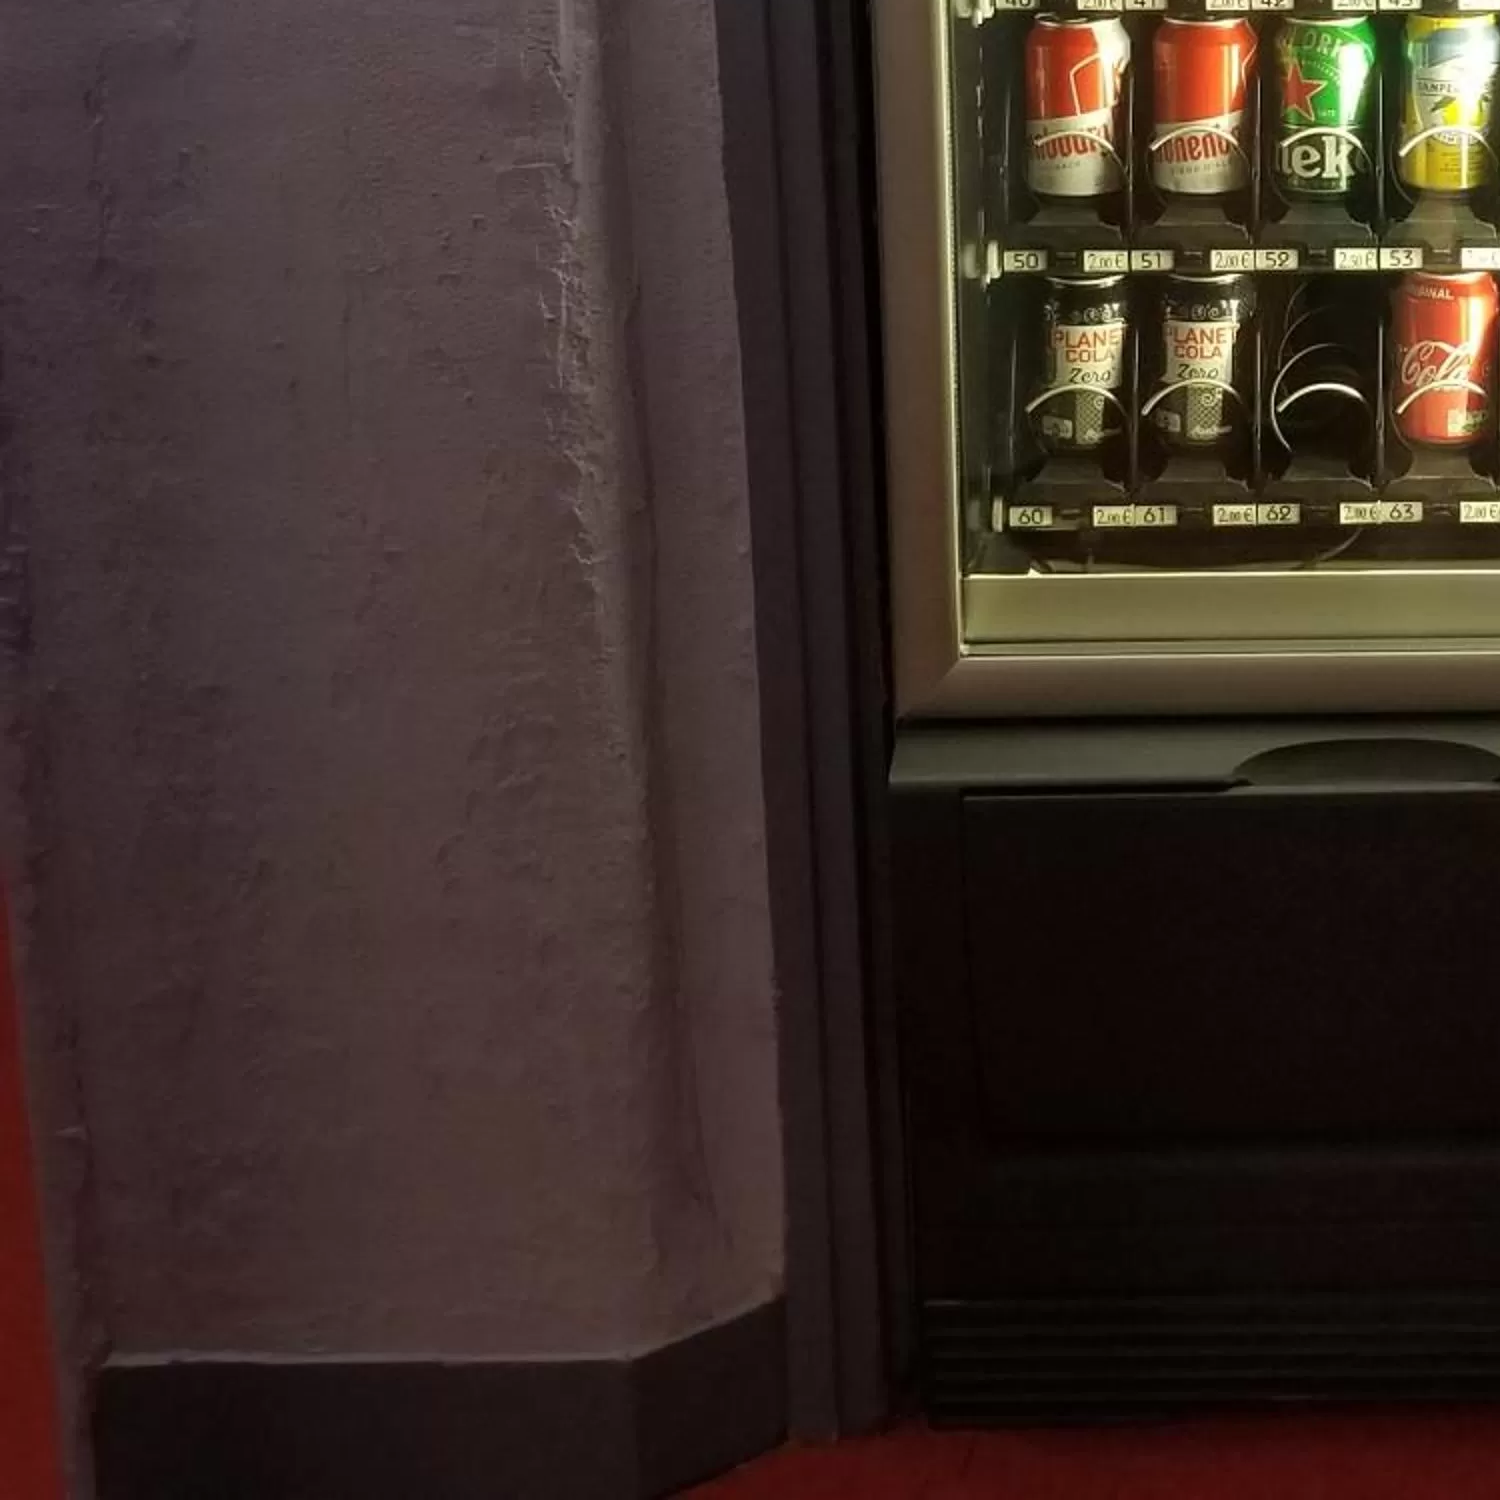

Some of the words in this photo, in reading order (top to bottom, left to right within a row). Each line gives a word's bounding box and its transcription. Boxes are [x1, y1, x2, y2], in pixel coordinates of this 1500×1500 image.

[1014, 252, 1039, 269] 50
[1141, 252, 1161, 268] 51
[1265, 251, 1289, 268] 52
[1389, 250, 1413, 267] 53
[1066, 348, 1115, 364] COLA
[1174, 345, 1223, 360] COLA
[1070, 367, 1111, 384] Zero
[1177, 363, 1219, 379] Zero
[1018, 510, 1043, 526] 60
[1144, 507, 1165, 524] 61
[1266, 506, 1291, 521] 62
[1389, 504, 1414, 520] 63
